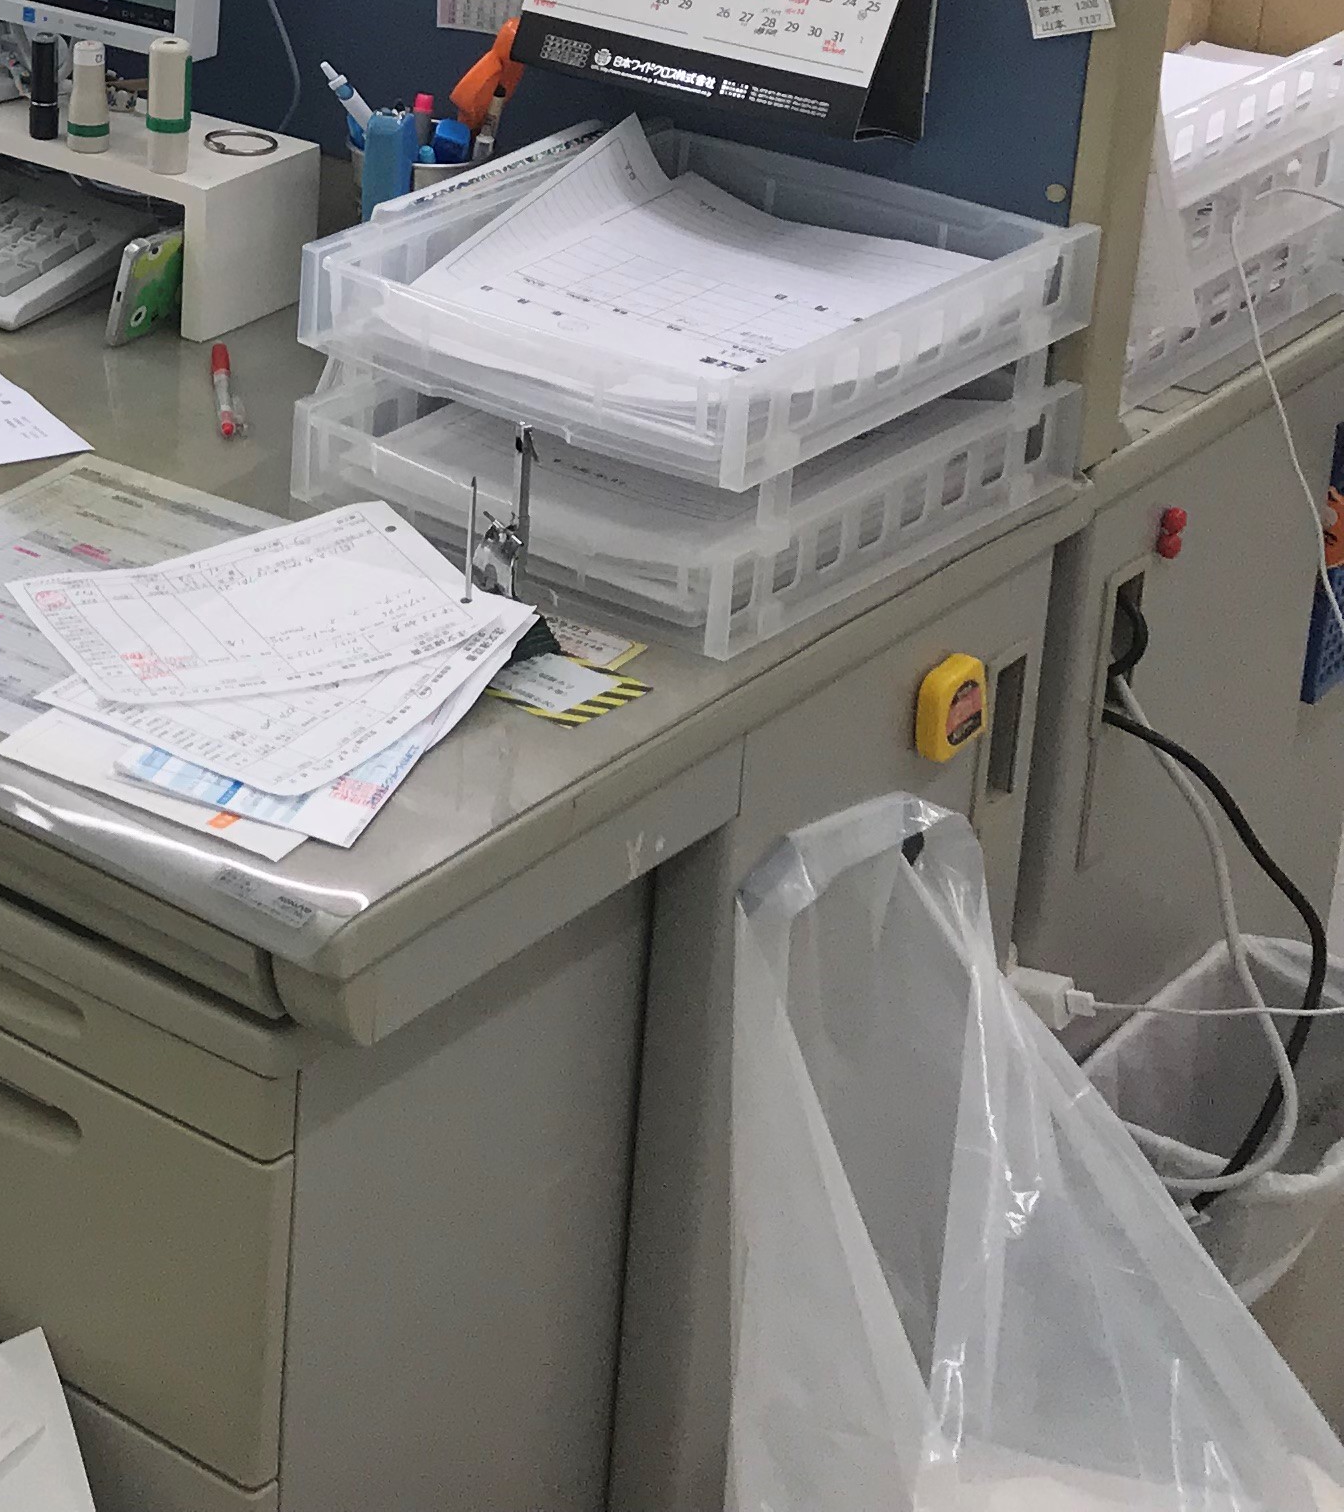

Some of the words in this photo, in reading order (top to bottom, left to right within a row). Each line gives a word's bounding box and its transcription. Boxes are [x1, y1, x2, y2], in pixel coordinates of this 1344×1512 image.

[678, 0, 692, 9] 29
[866, 1, 881, 12] 25
[716, 7, 730, 18] 26
[739, 12, 754, 23] 27
[762, 17, 776, 28] 28
[785, 21, 799, 33] 29
[808, 26, 822, 37] 30
[831, 31, 844, 42] 31
[1041, 20, 1067, 31] 山本
